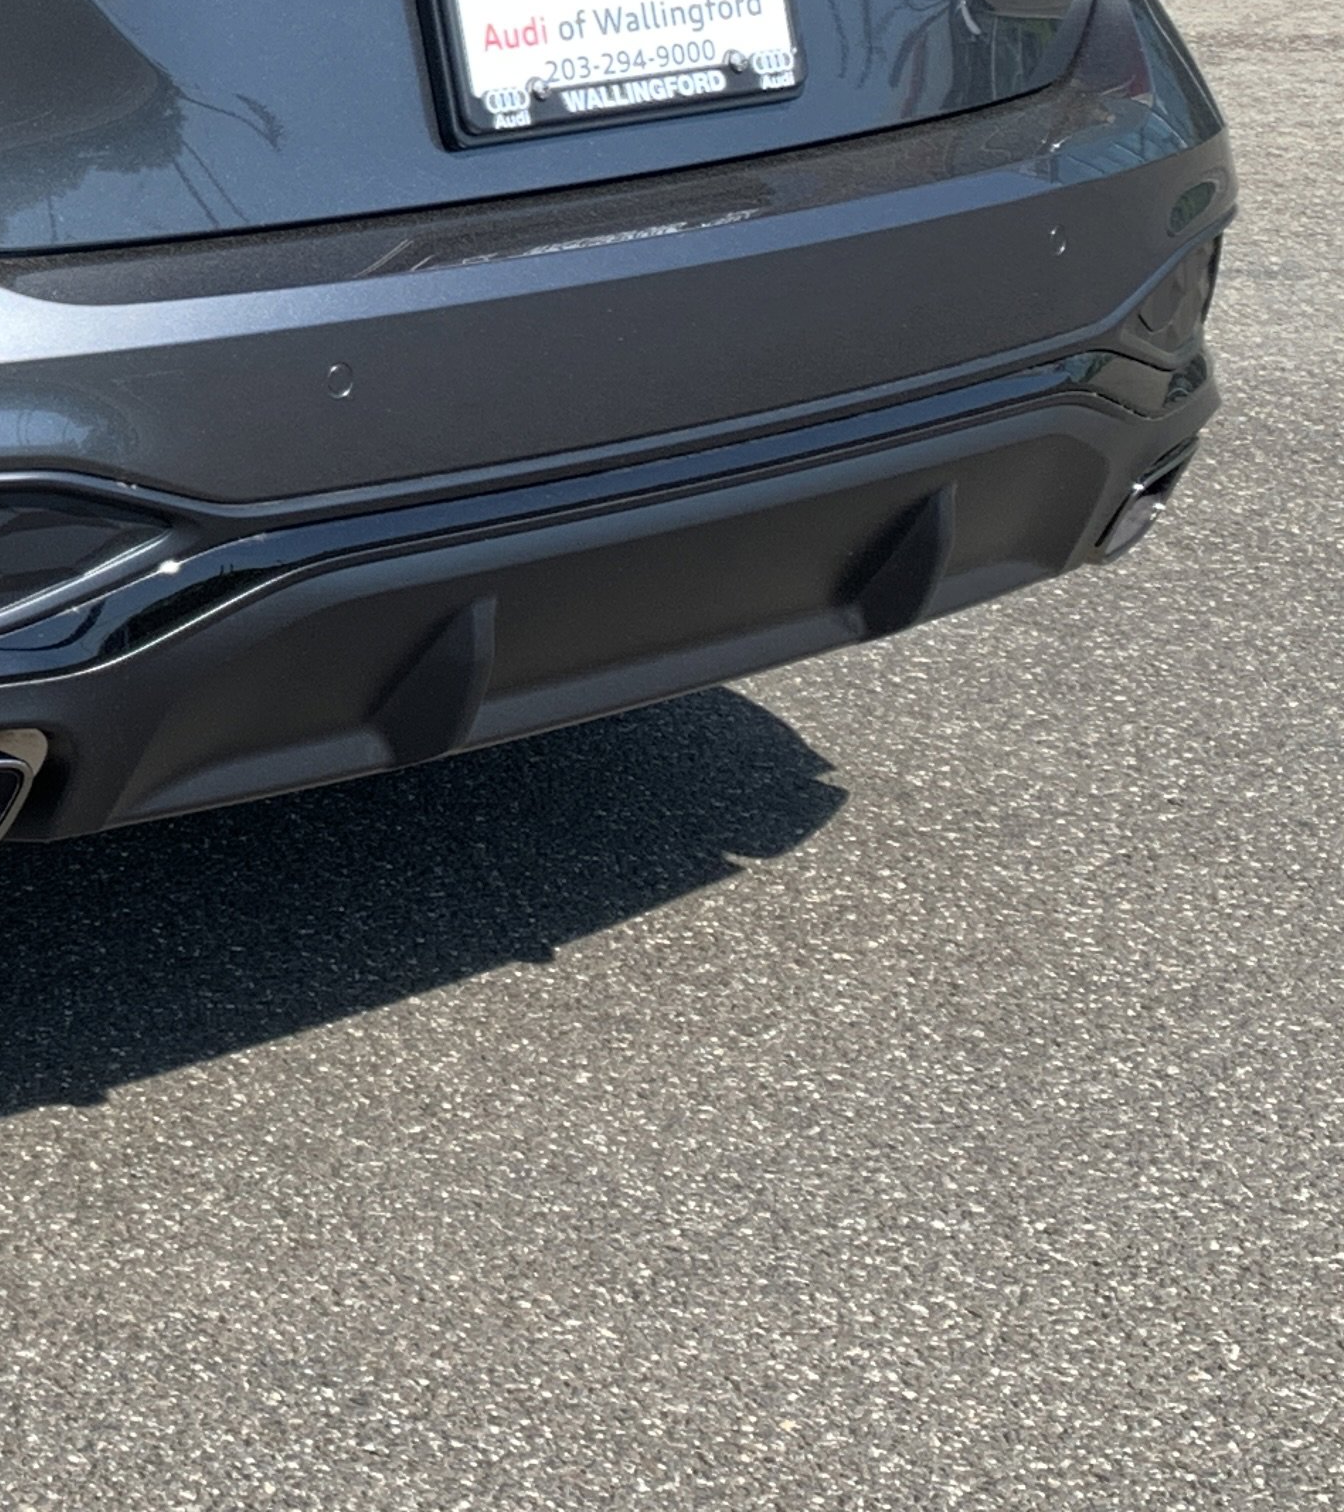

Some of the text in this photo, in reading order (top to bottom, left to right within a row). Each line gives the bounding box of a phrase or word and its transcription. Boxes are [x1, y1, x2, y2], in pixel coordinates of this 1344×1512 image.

[484, 16, 548, 51] Audi
[558, 9, 586, 41] of
[544, 39, 716, 84] 203-294-9000
[761, 71, 796, 90] Audi
[561, 69, 727, 113] WALLINGFORD
[493, 110, 532, 129] Audi
